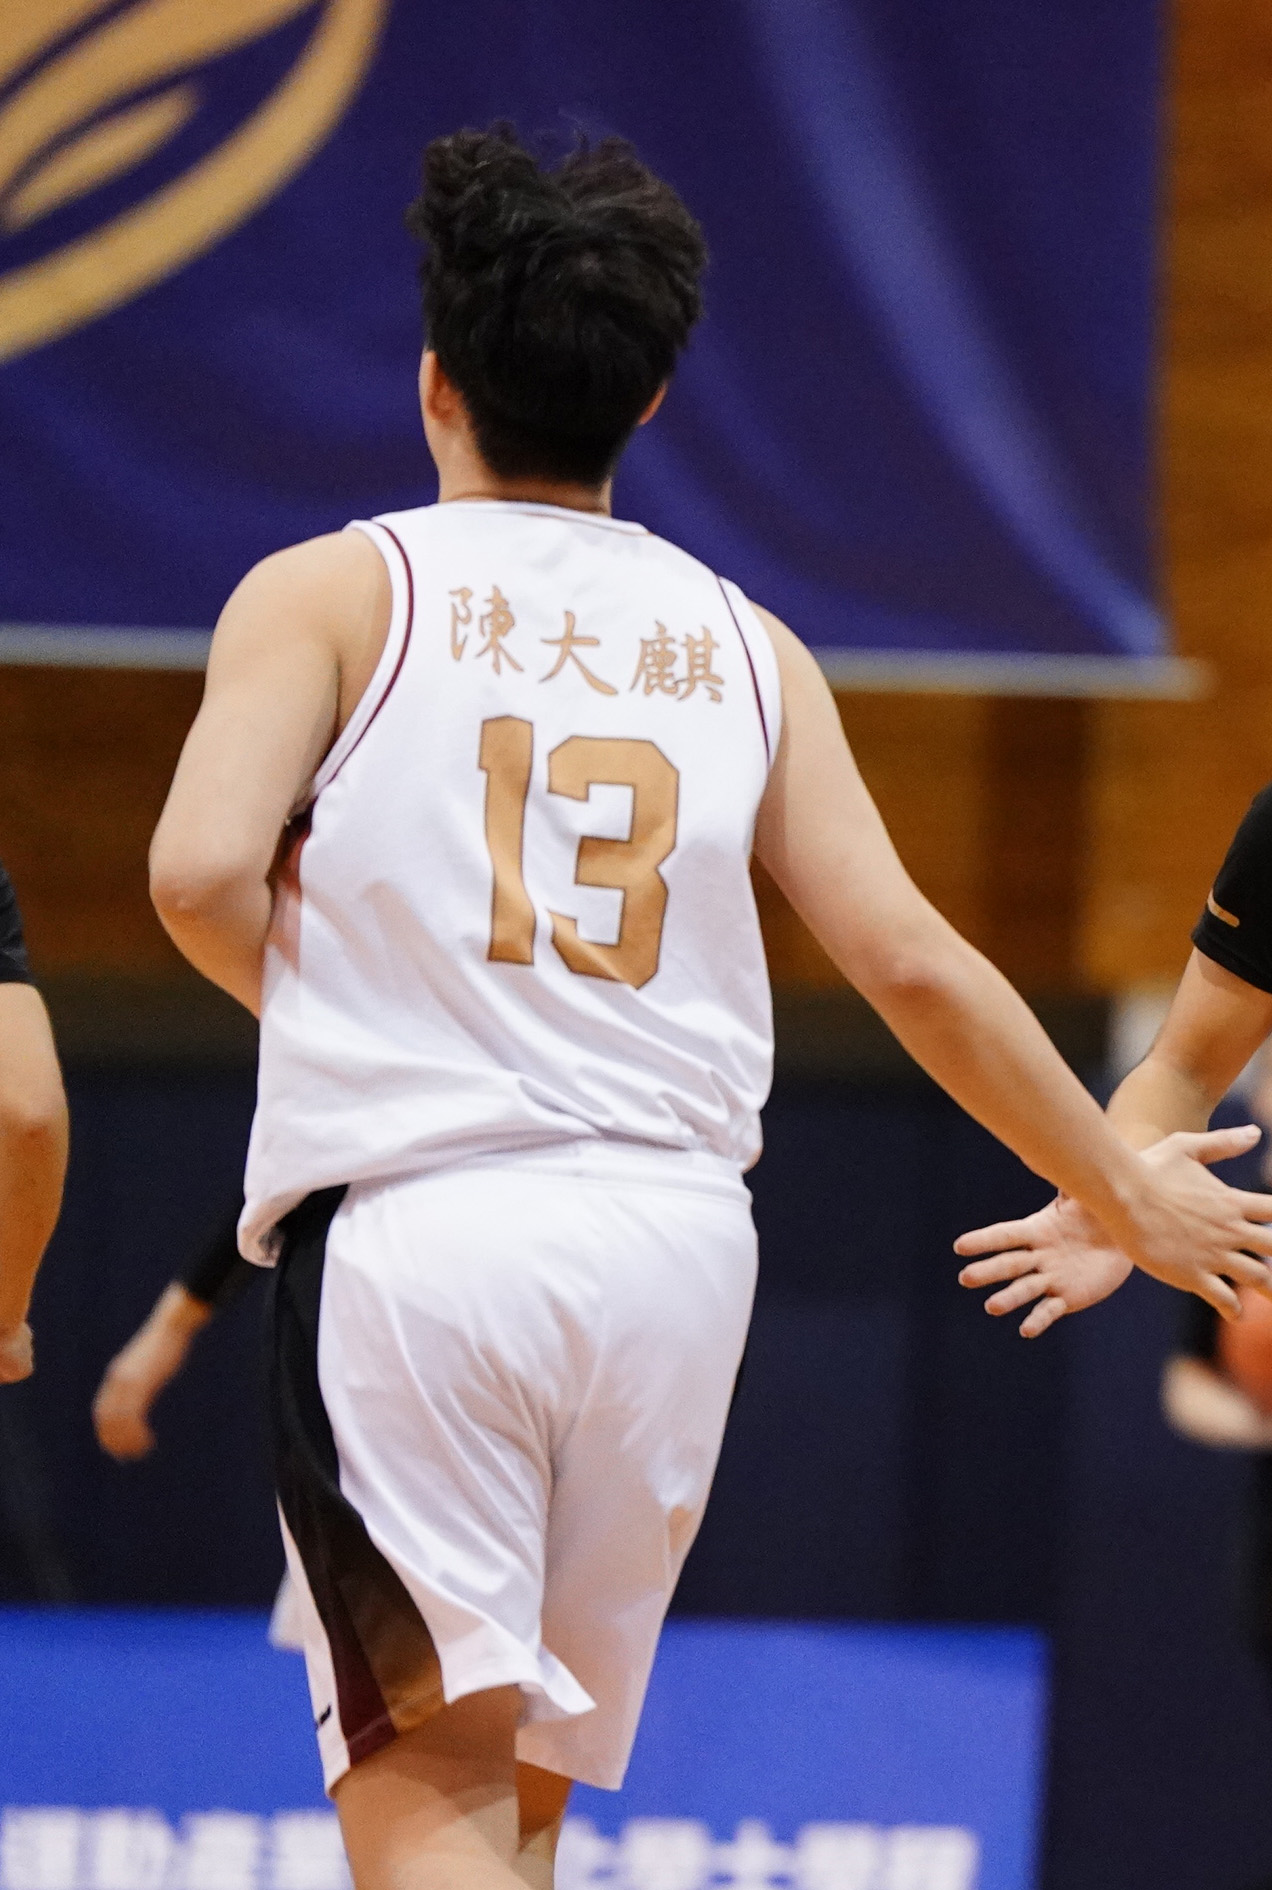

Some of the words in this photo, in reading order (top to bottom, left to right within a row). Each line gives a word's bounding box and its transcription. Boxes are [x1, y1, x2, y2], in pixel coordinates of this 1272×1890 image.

[448, 585, 725, 704] 陳大麒
[478, 714, 681, 990] 13
